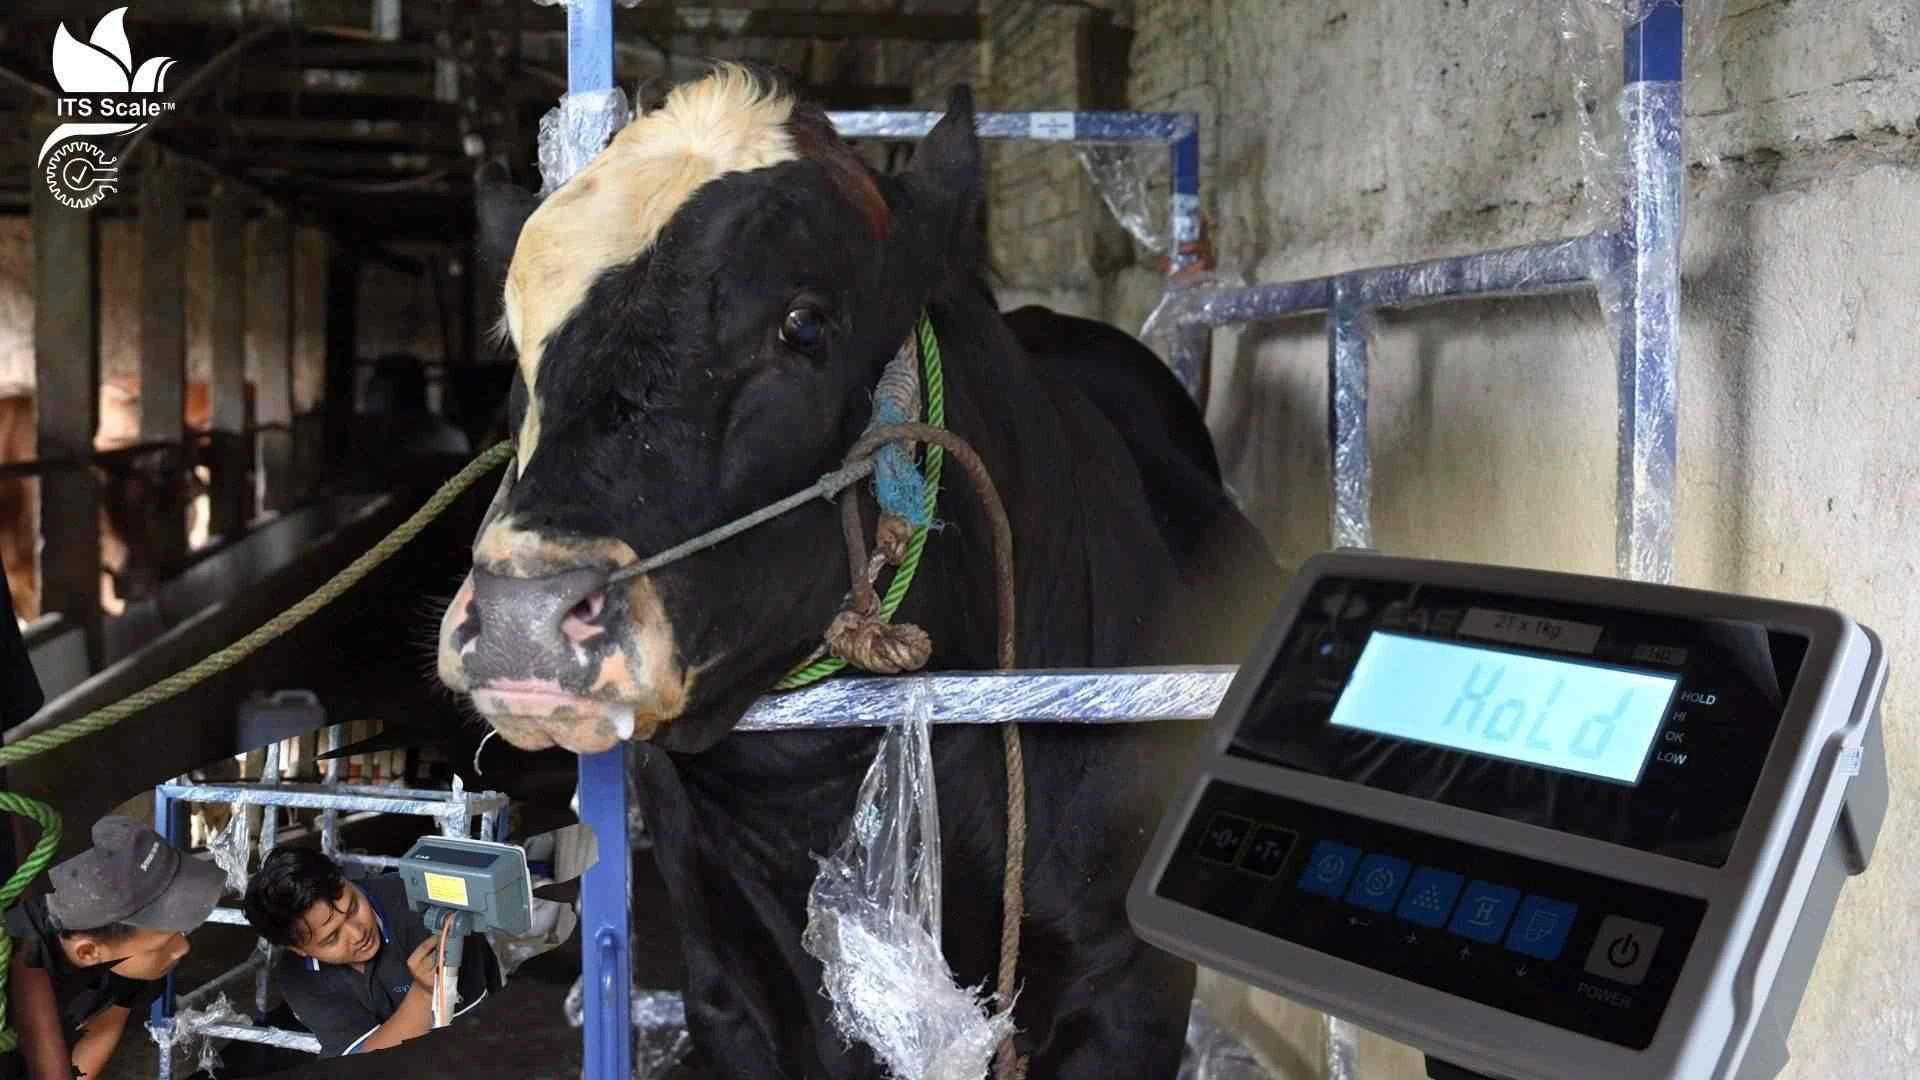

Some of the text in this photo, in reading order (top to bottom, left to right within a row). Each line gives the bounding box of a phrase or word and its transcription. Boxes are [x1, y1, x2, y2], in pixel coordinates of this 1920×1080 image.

[1680, 690, 1717, 705] HOLD
[1672, 711, 1688, 721] HI
[1664, 731, 1686, 743] OK
[1656, 751, 1688, 765] LOW
[1577, 981, 1632, 1008] POWER
